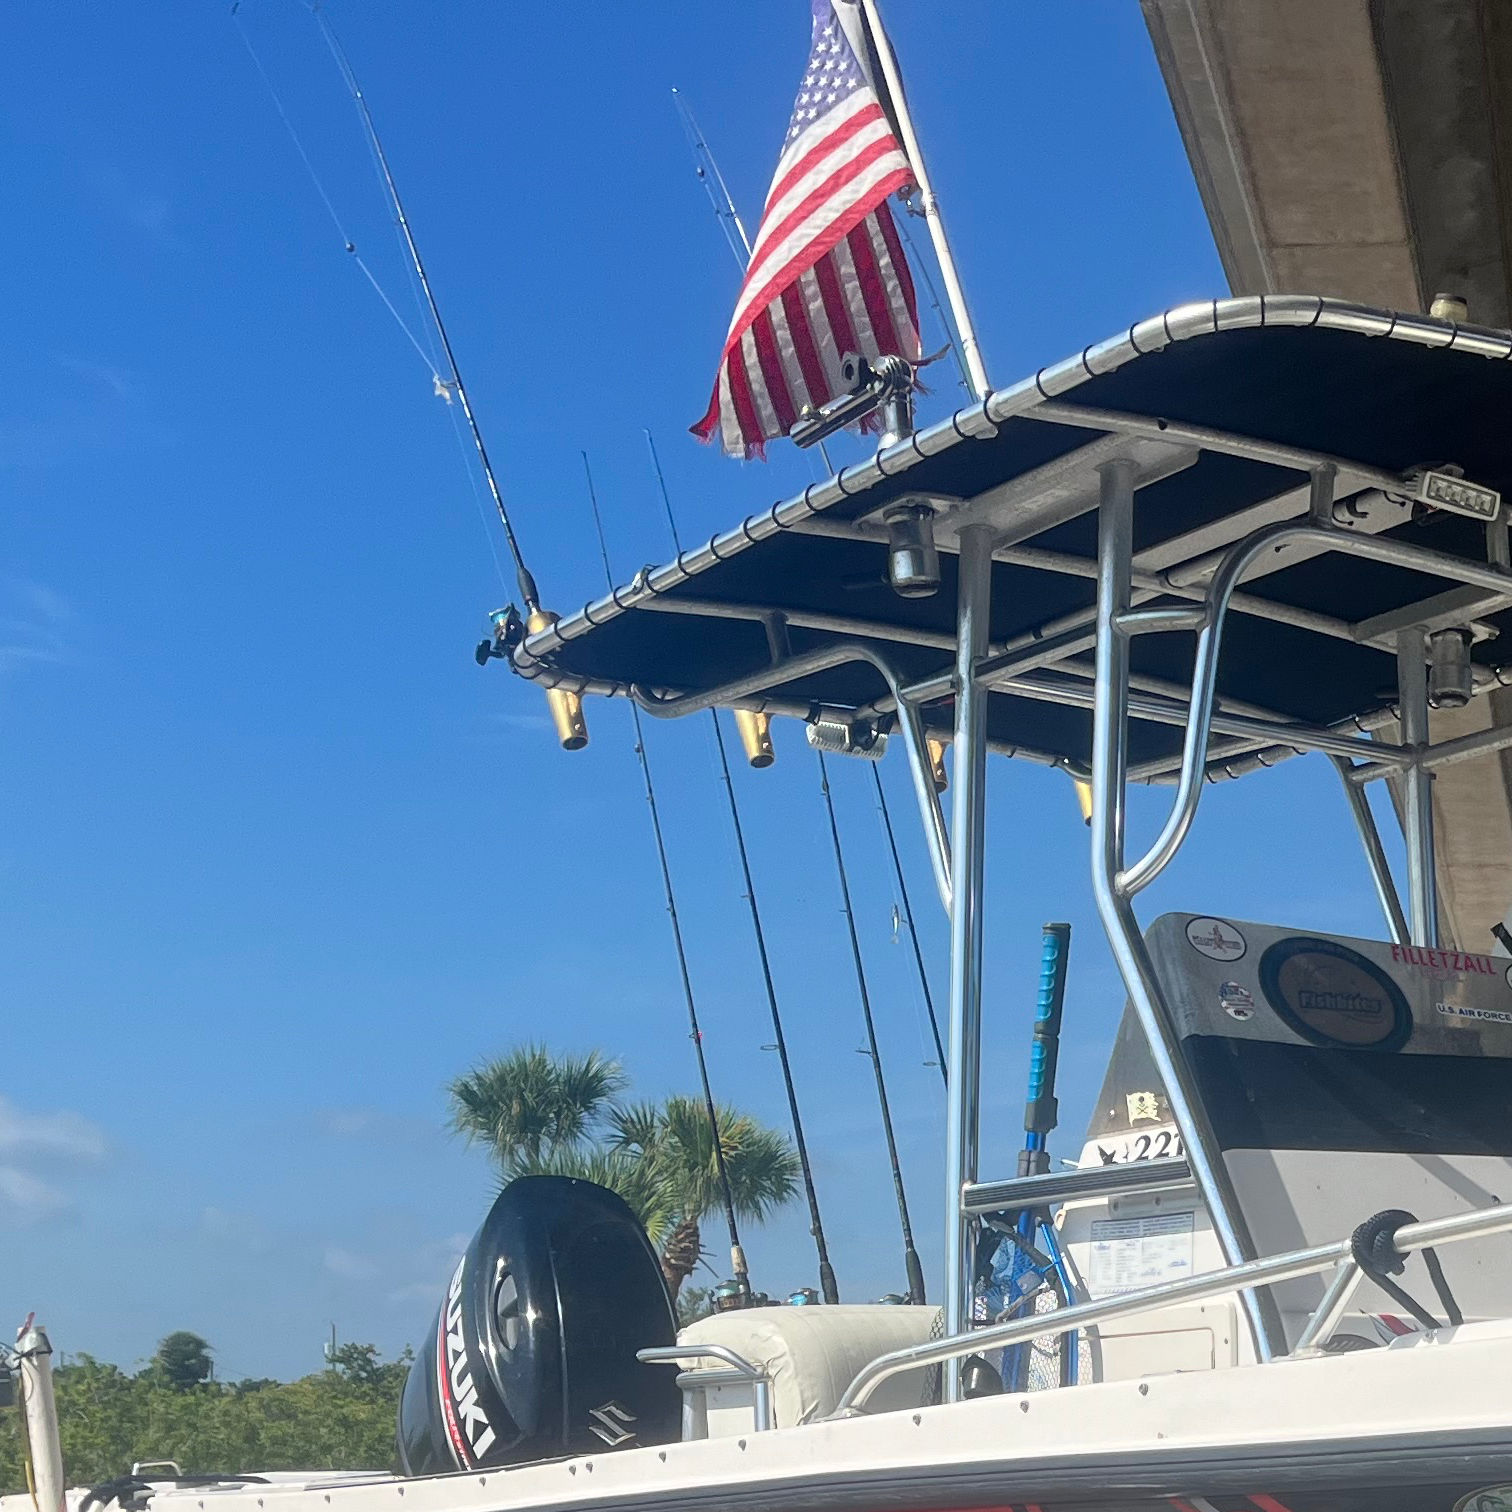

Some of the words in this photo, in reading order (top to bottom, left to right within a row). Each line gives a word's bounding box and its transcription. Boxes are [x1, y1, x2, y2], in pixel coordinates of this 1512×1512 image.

[1390, 943, 1498, 976] FILLETZALL
[1437, 1004, 1457, 1014] U.S.
[1458, 1008, 1476, 1018] AIR
[1477, 1010, 1512, 1022] FORCE
